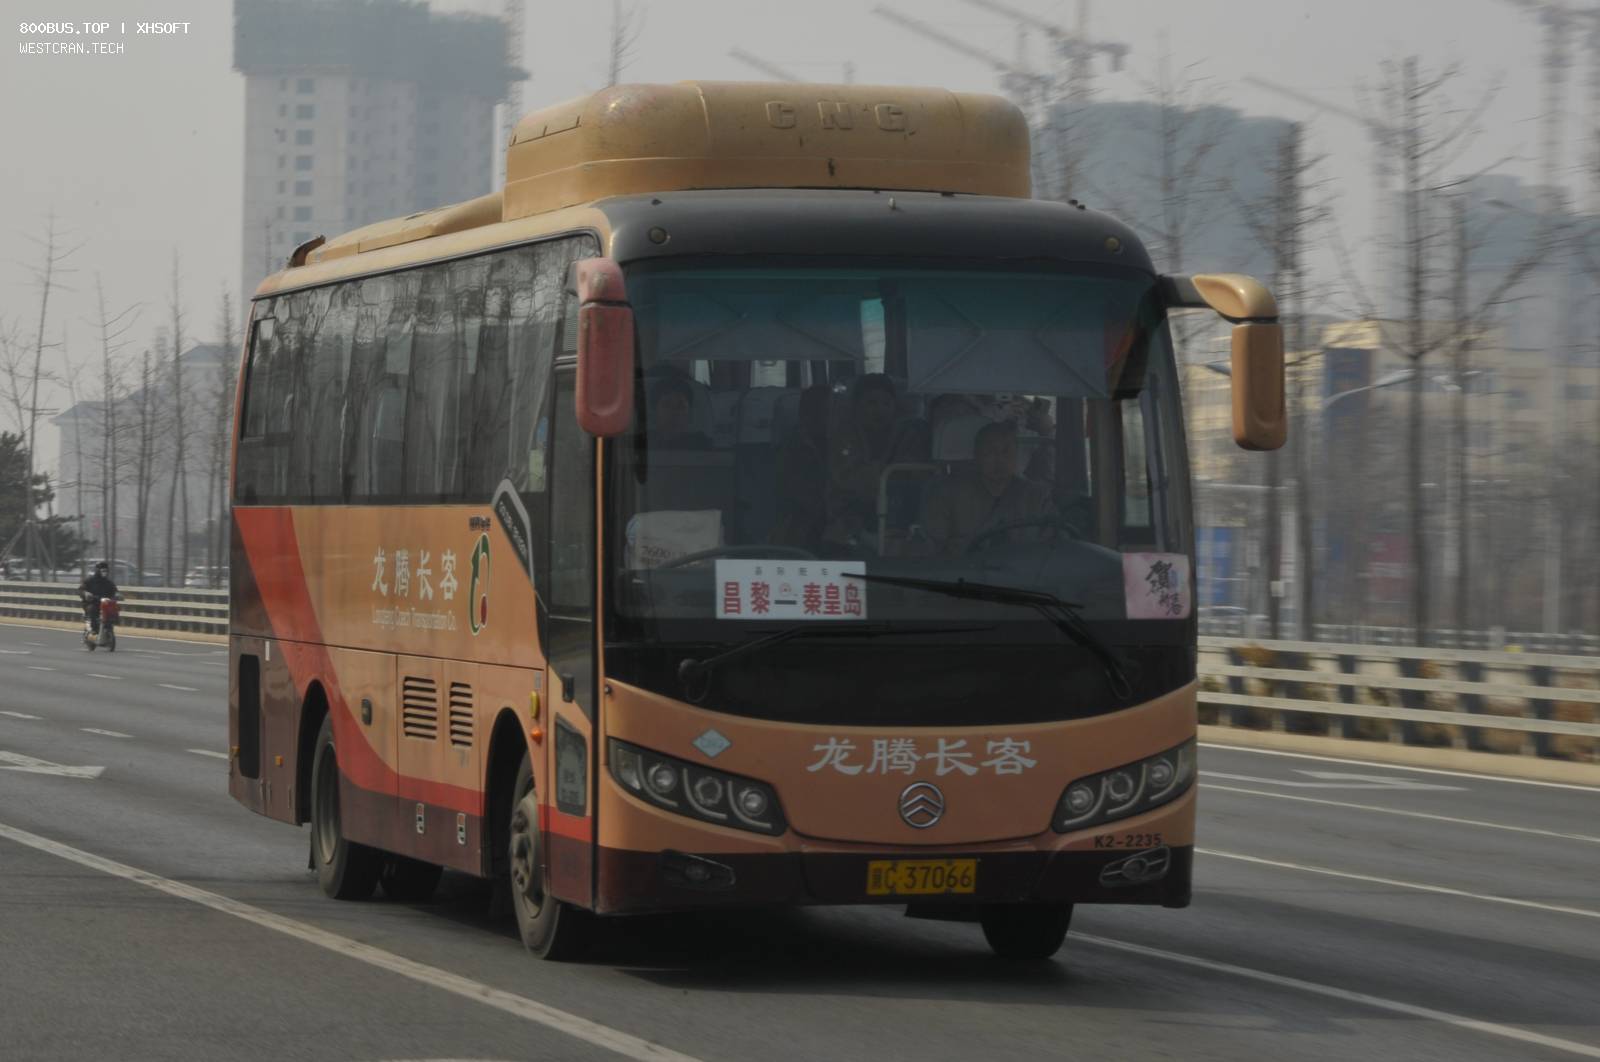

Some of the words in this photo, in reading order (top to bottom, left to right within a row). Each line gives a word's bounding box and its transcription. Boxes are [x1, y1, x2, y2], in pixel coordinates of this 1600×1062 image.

[372, 546, 458, 600] 龙腾长客
[806, 736, 1038, 777] 龙腾长客
[1094, 834, 1163, 849] K2-2235
